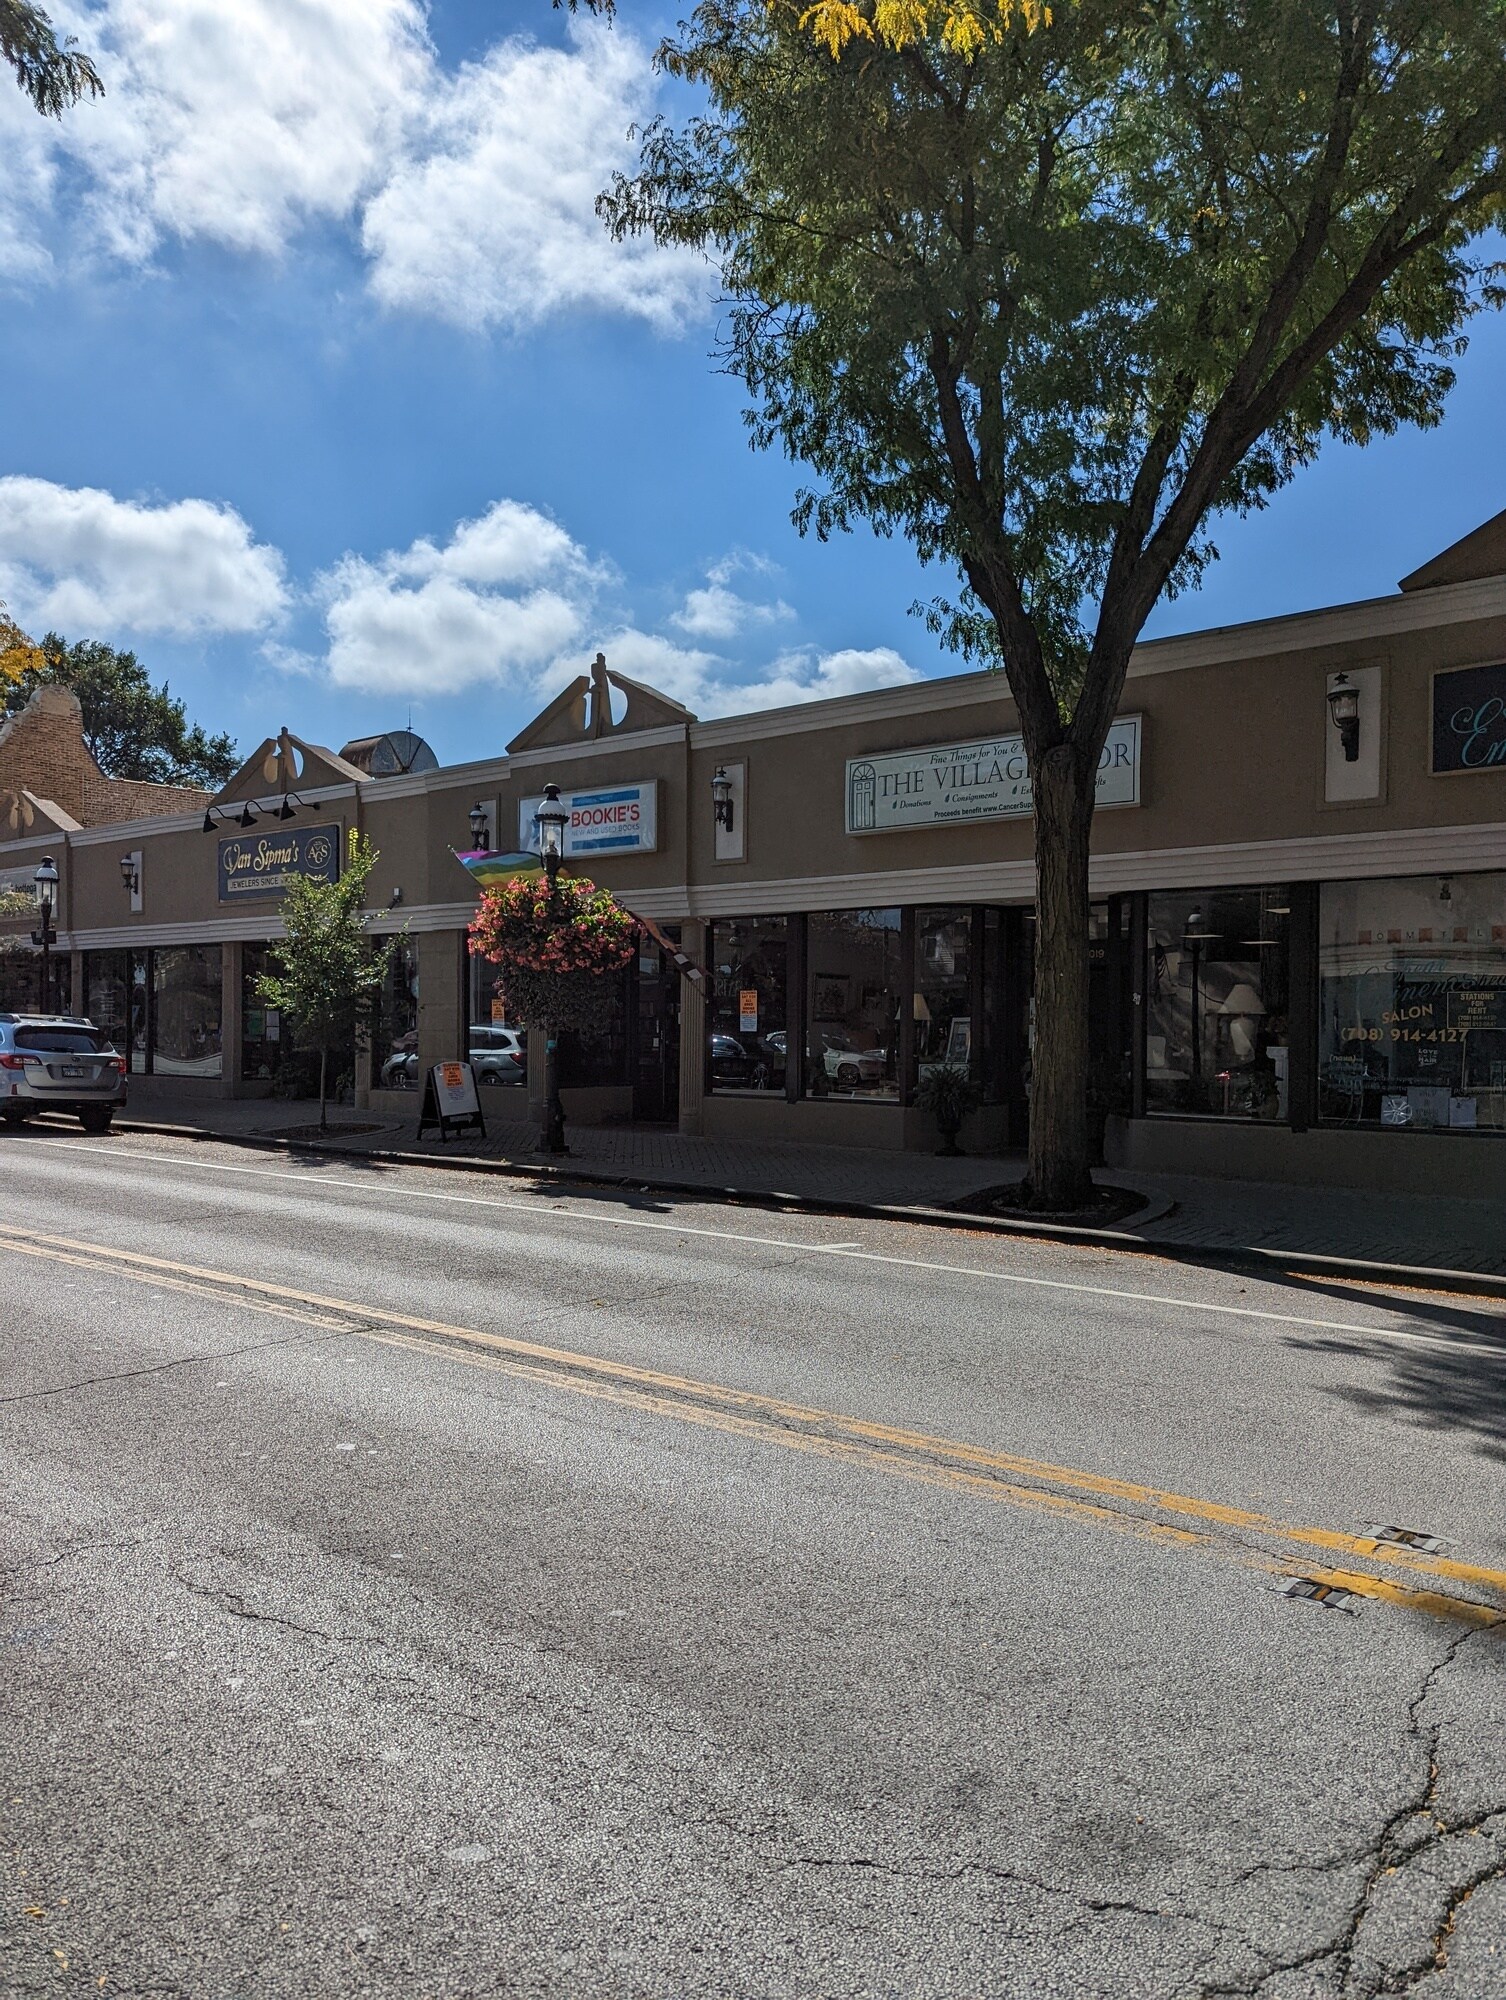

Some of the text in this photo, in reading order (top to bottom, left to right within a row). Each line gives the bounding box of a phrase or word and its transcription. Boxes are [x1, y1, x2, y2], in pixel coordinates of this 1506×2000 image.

[930, 754, 947, 765] Fine
[950, 749, 976, 762] Things
[977, 746, 990, 761] for
[993, 745, 1008, 756] You
[1010, 743, 1019, 753] &
[878, 770, 924, 797] THE
[899, 799, 931, 809] Donations
[952, 791, 998, 803] Consignments
[571, 804, 640, 828] BOOKIE'S
[934, 808, 960, 818] Proceeds
[962, 806, 982, 815] benefit
[571, 824, 640, 837] NEW AND USED BOOKS
[223, 840, 299, 875] Van Sipma's
[230, 878, 260, 890] JEWELERS
[260, 876, 279, 887] SINCE
[1460, 993, 1495, 1001] STATIONS
[1382, 1003, 1433, 1024] SALON
[1467, 1006, 1487, 1014] RENT
[1341, 1027, 1469, 1042] (708) 914-4127
